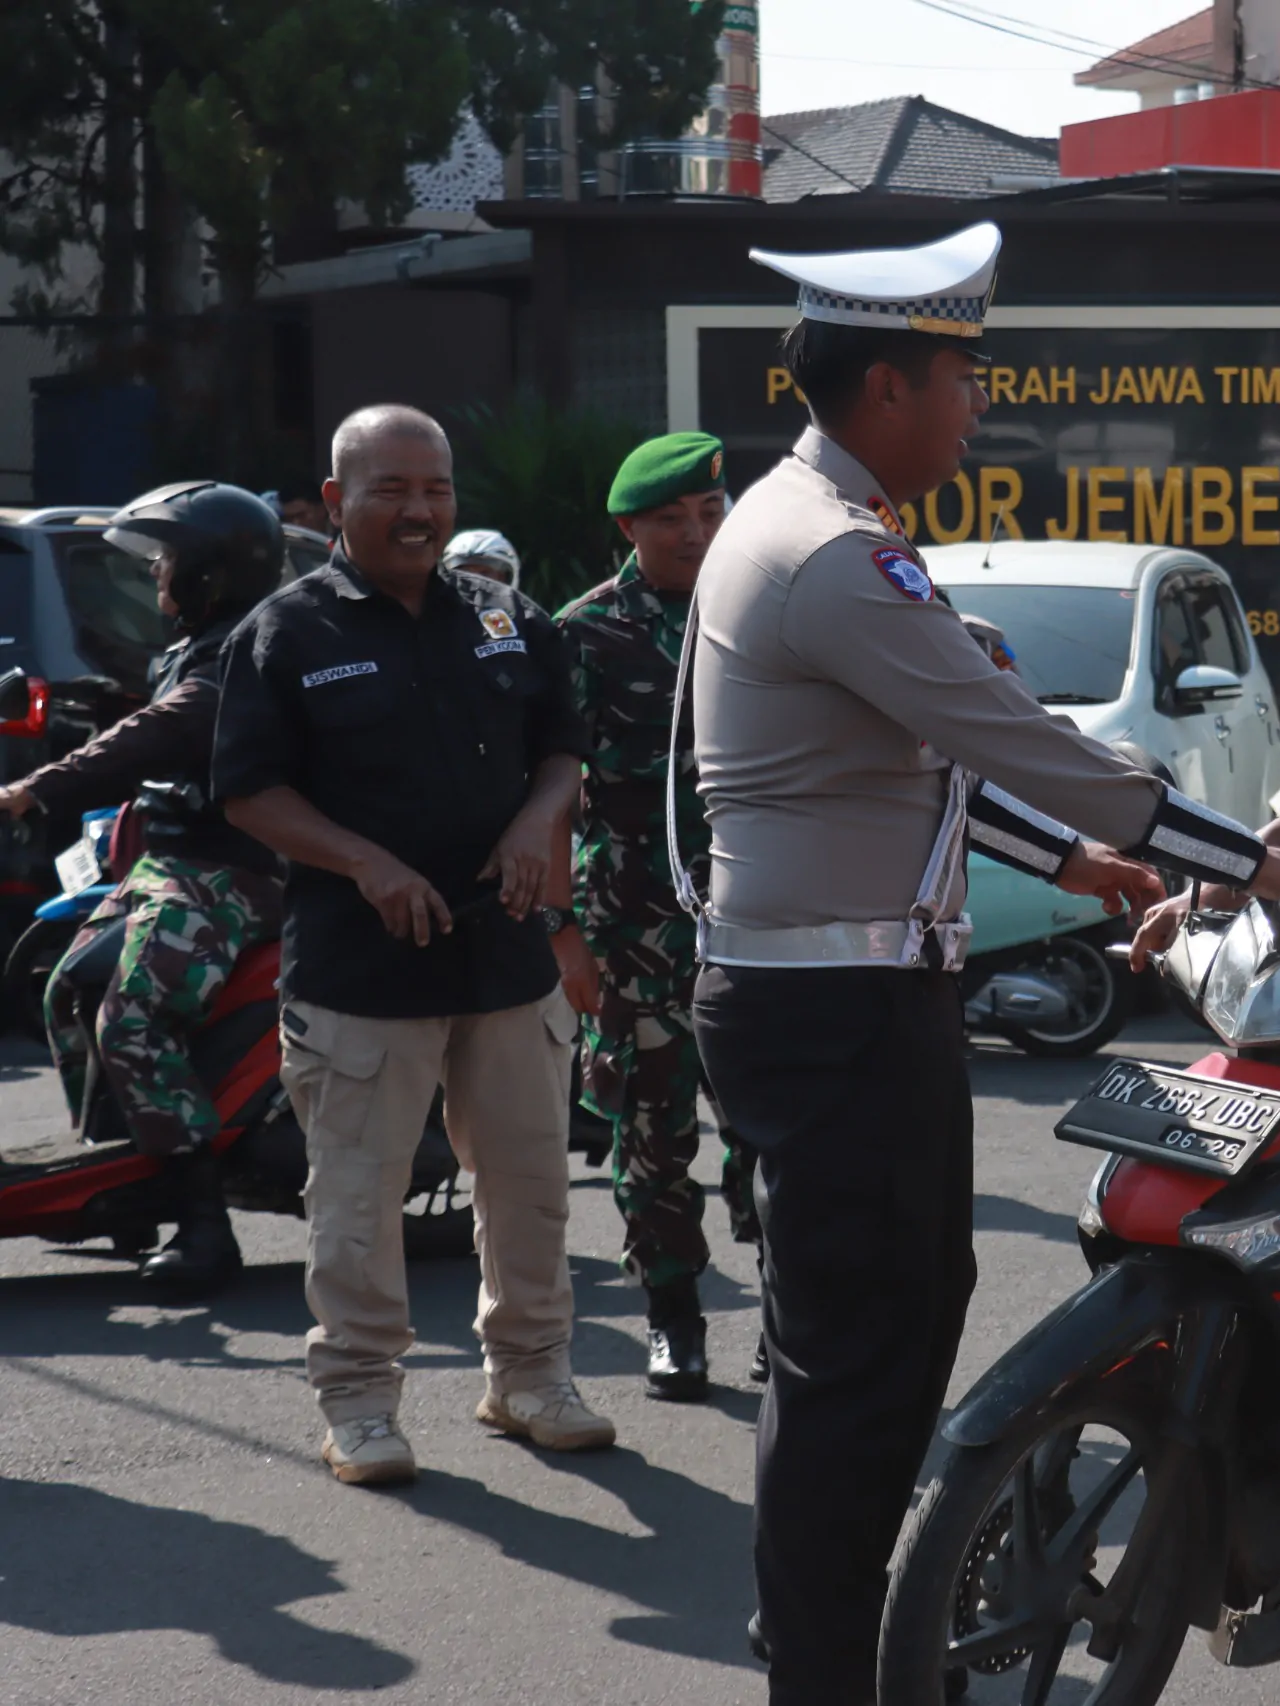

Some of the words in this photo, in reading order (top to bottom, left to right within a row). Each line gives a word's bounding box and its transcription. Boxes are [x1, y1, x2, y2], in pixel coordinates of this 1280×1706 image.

[1089, 367, 1205, 405] JAWA
[306, 663, 375, 686] SISWANDI
[1099, 1074, 1147, 1104] DK
[1140, 1083, 1221, 1120] 2664
[1212, 1096, 1273, 1134] UBC
